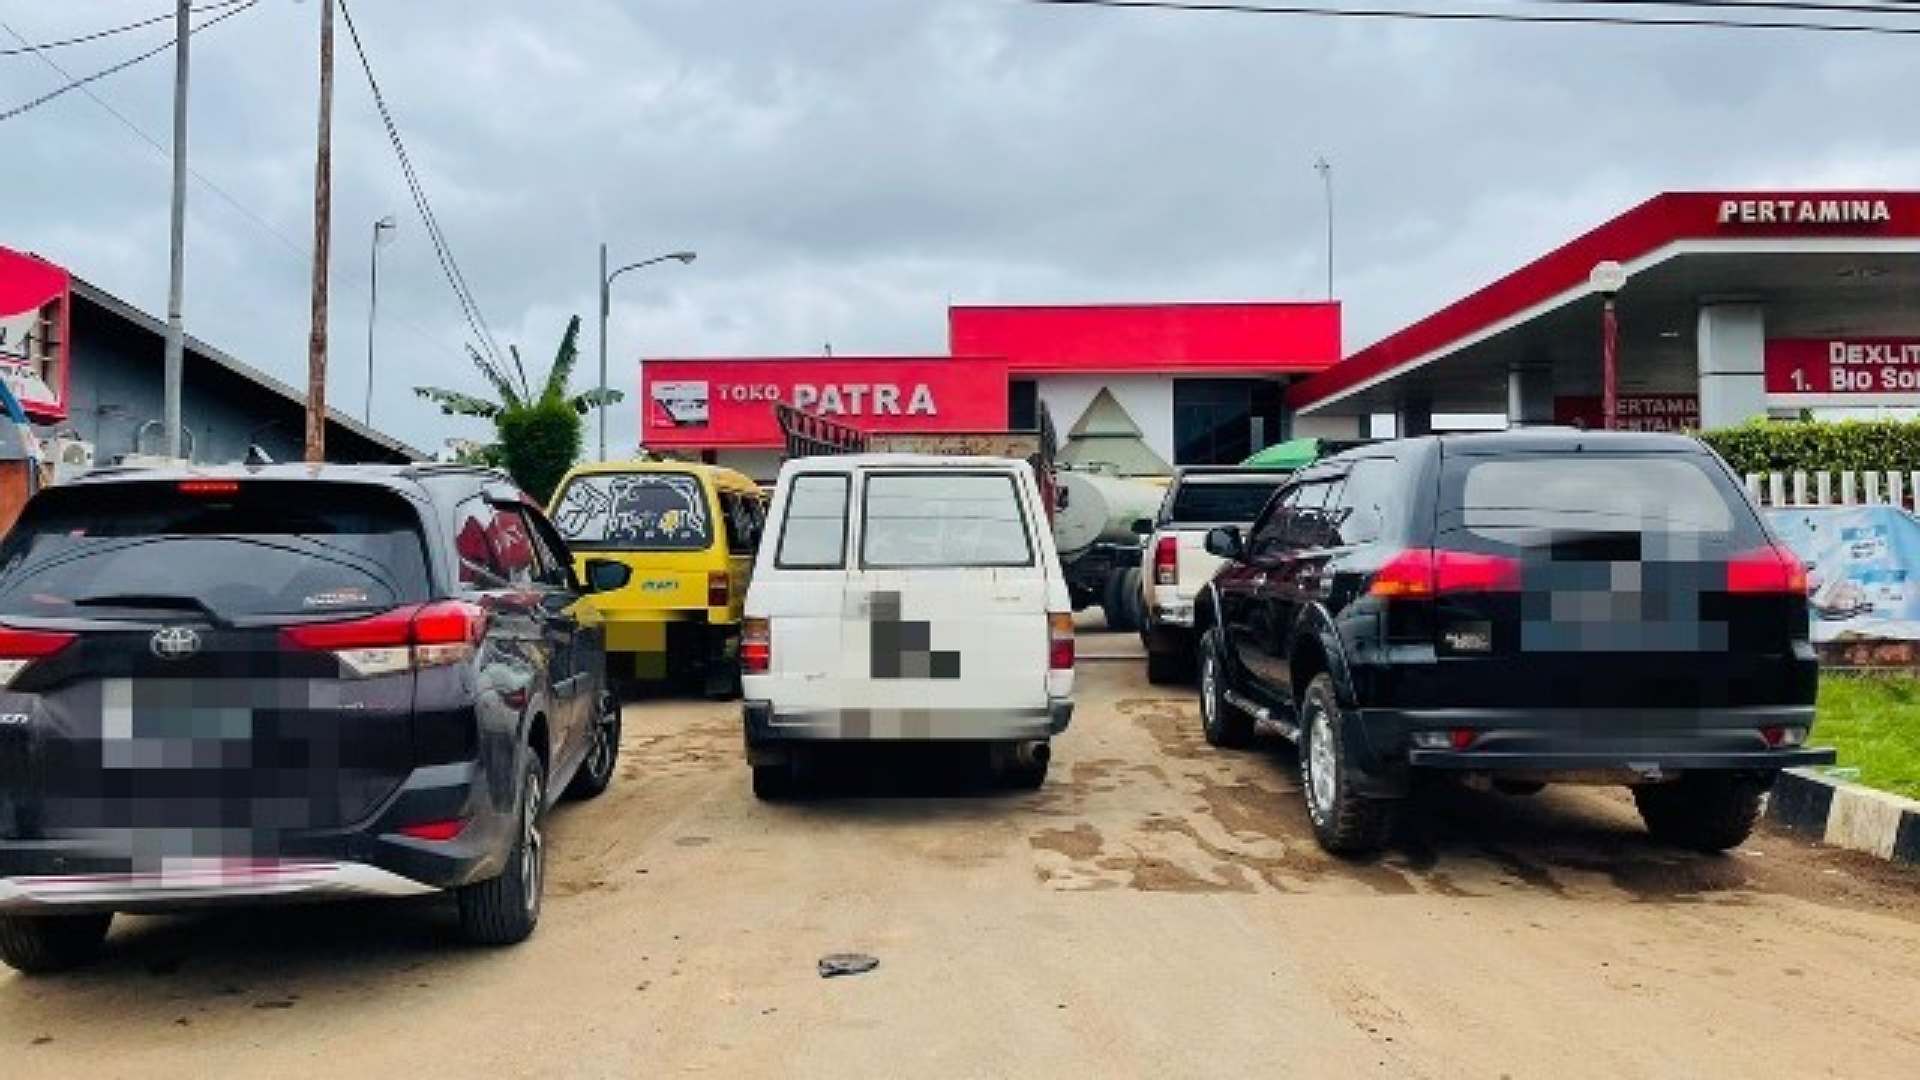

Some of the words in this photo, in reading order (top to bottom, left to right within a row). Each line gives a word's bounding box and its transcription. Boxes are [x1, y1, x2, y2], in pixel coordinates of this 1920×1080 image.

[1718, 200, 1890, 223] PERTAMINA
[1790, 367, 1812, 391] 1.
[719, 384, 781, 401] TOKO
[792, 383, 937, 416] PATRA
[1604, 399, 1698, 415] ERTAMA
